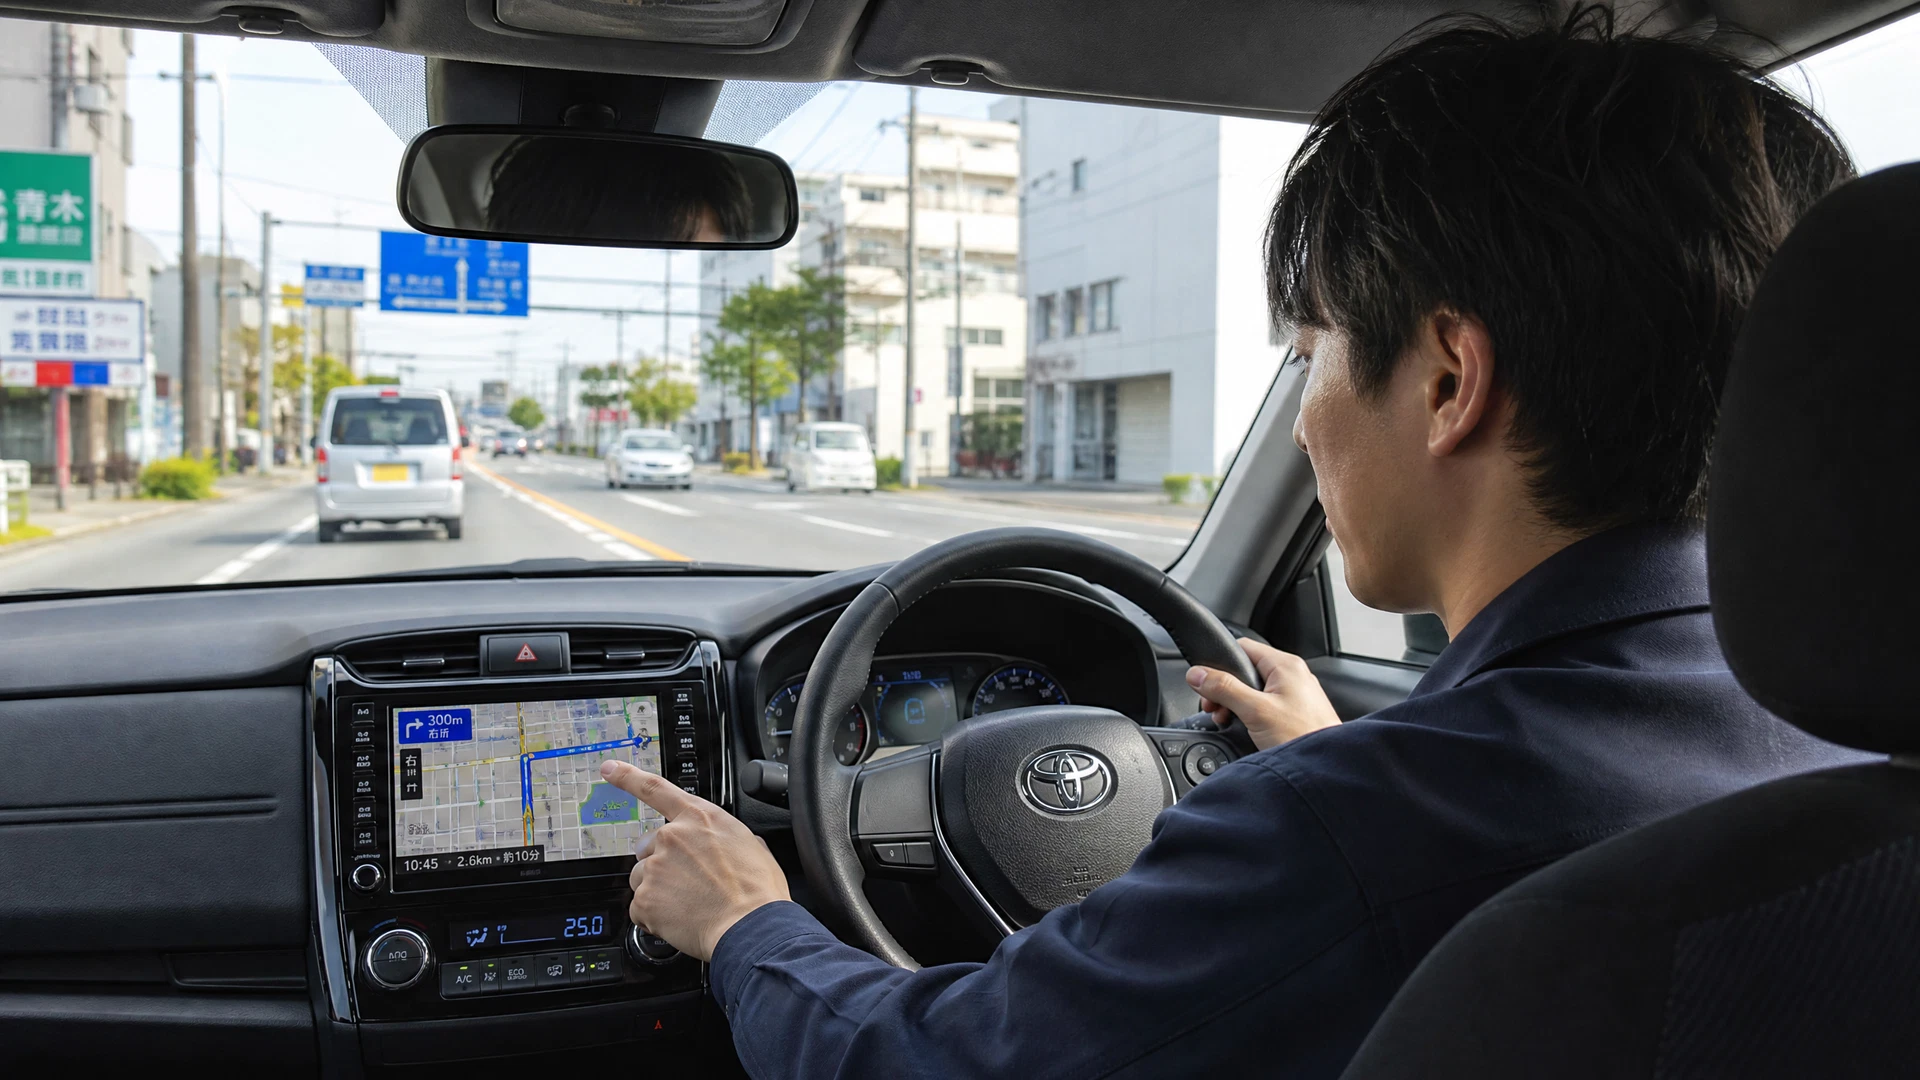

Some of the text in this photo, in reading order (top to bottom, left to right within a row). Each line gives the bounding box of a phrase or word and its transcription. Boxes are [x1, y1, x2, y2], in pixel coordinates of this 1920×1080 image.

[13, 188, 85, 224] 青木
[428, 714, 463, 727] 300m
[404, 858, 439, 871] 10:45
[564, 916, 603, 937] 25.0
[508, 968, 525, 976] ECO
[455, 975, 472, 984] A/C
